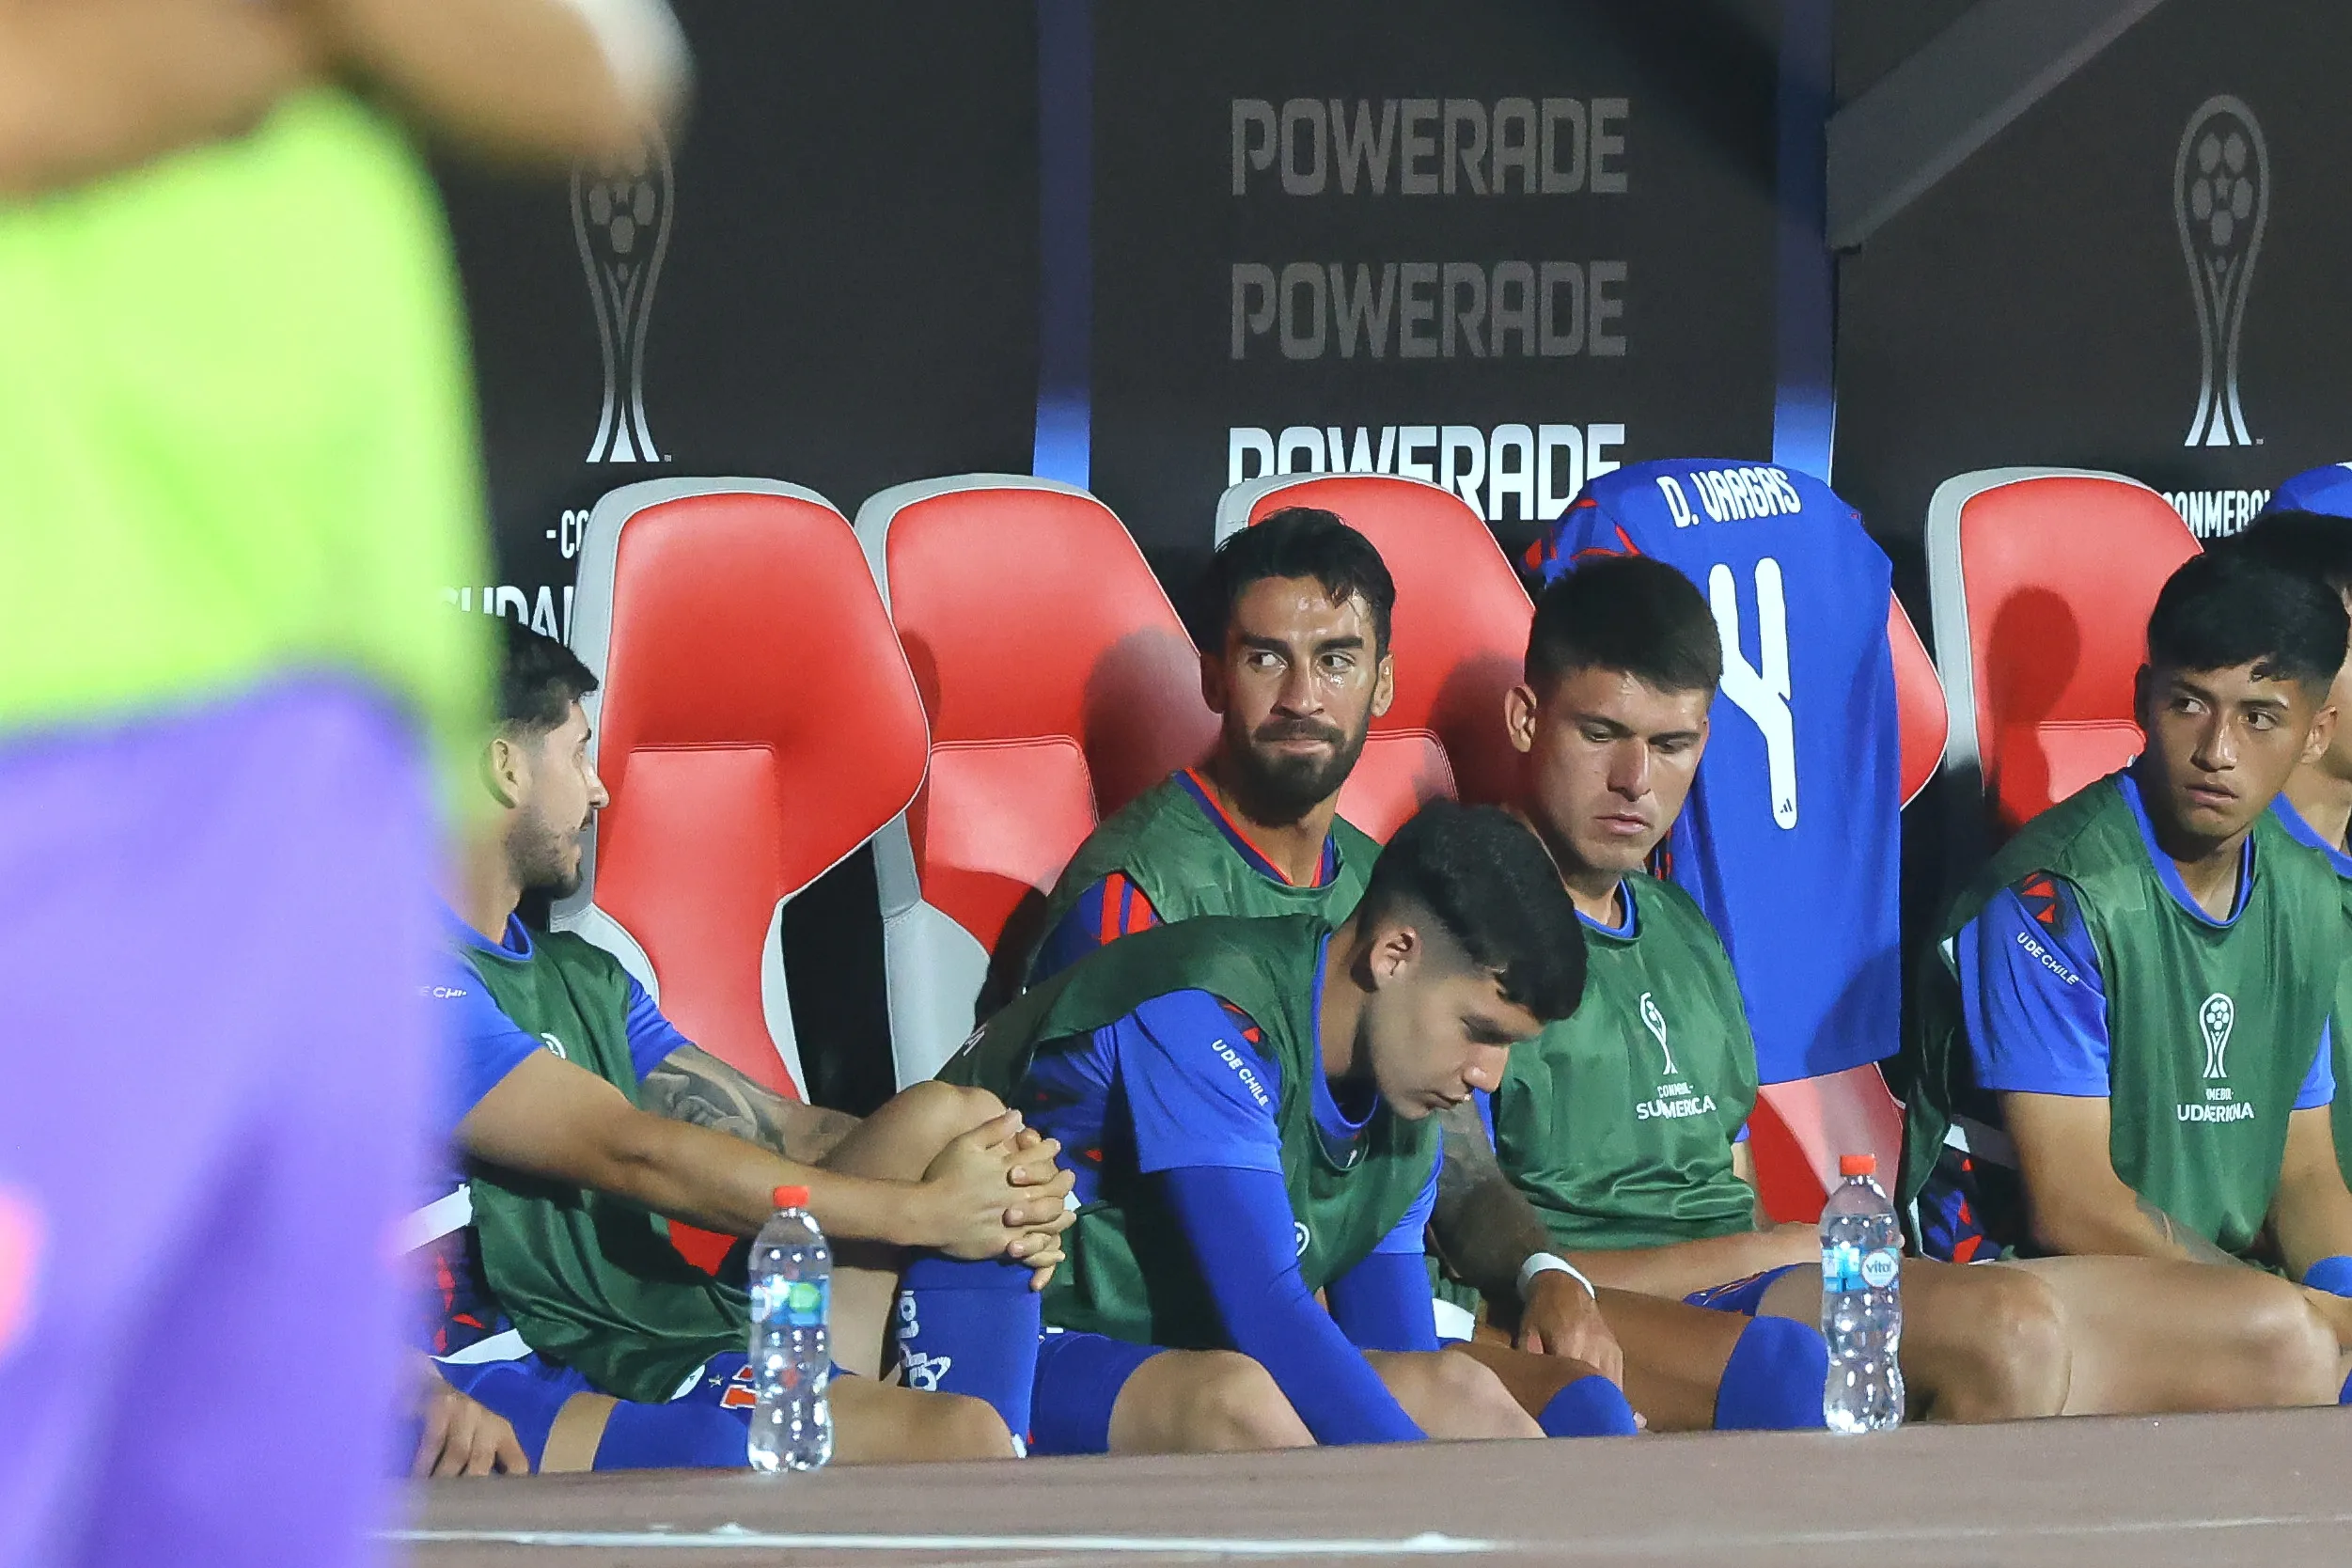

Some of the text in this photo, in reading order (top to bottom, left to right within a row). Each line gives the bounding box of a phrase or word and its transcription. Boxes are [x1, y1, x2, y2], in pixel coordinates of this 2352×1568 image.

[1231, 97, 1630, 196] POWERADE
[1231, 260, 1628, 361] POWERADE
[1656, 466, 1802, 528] D. VARGAS
[1708, 557, 1798, 830] 4
[2016, 932, 2079, 985] U DE CHILE
[1212, 1039, 1269, 1106] U DE CHILE
